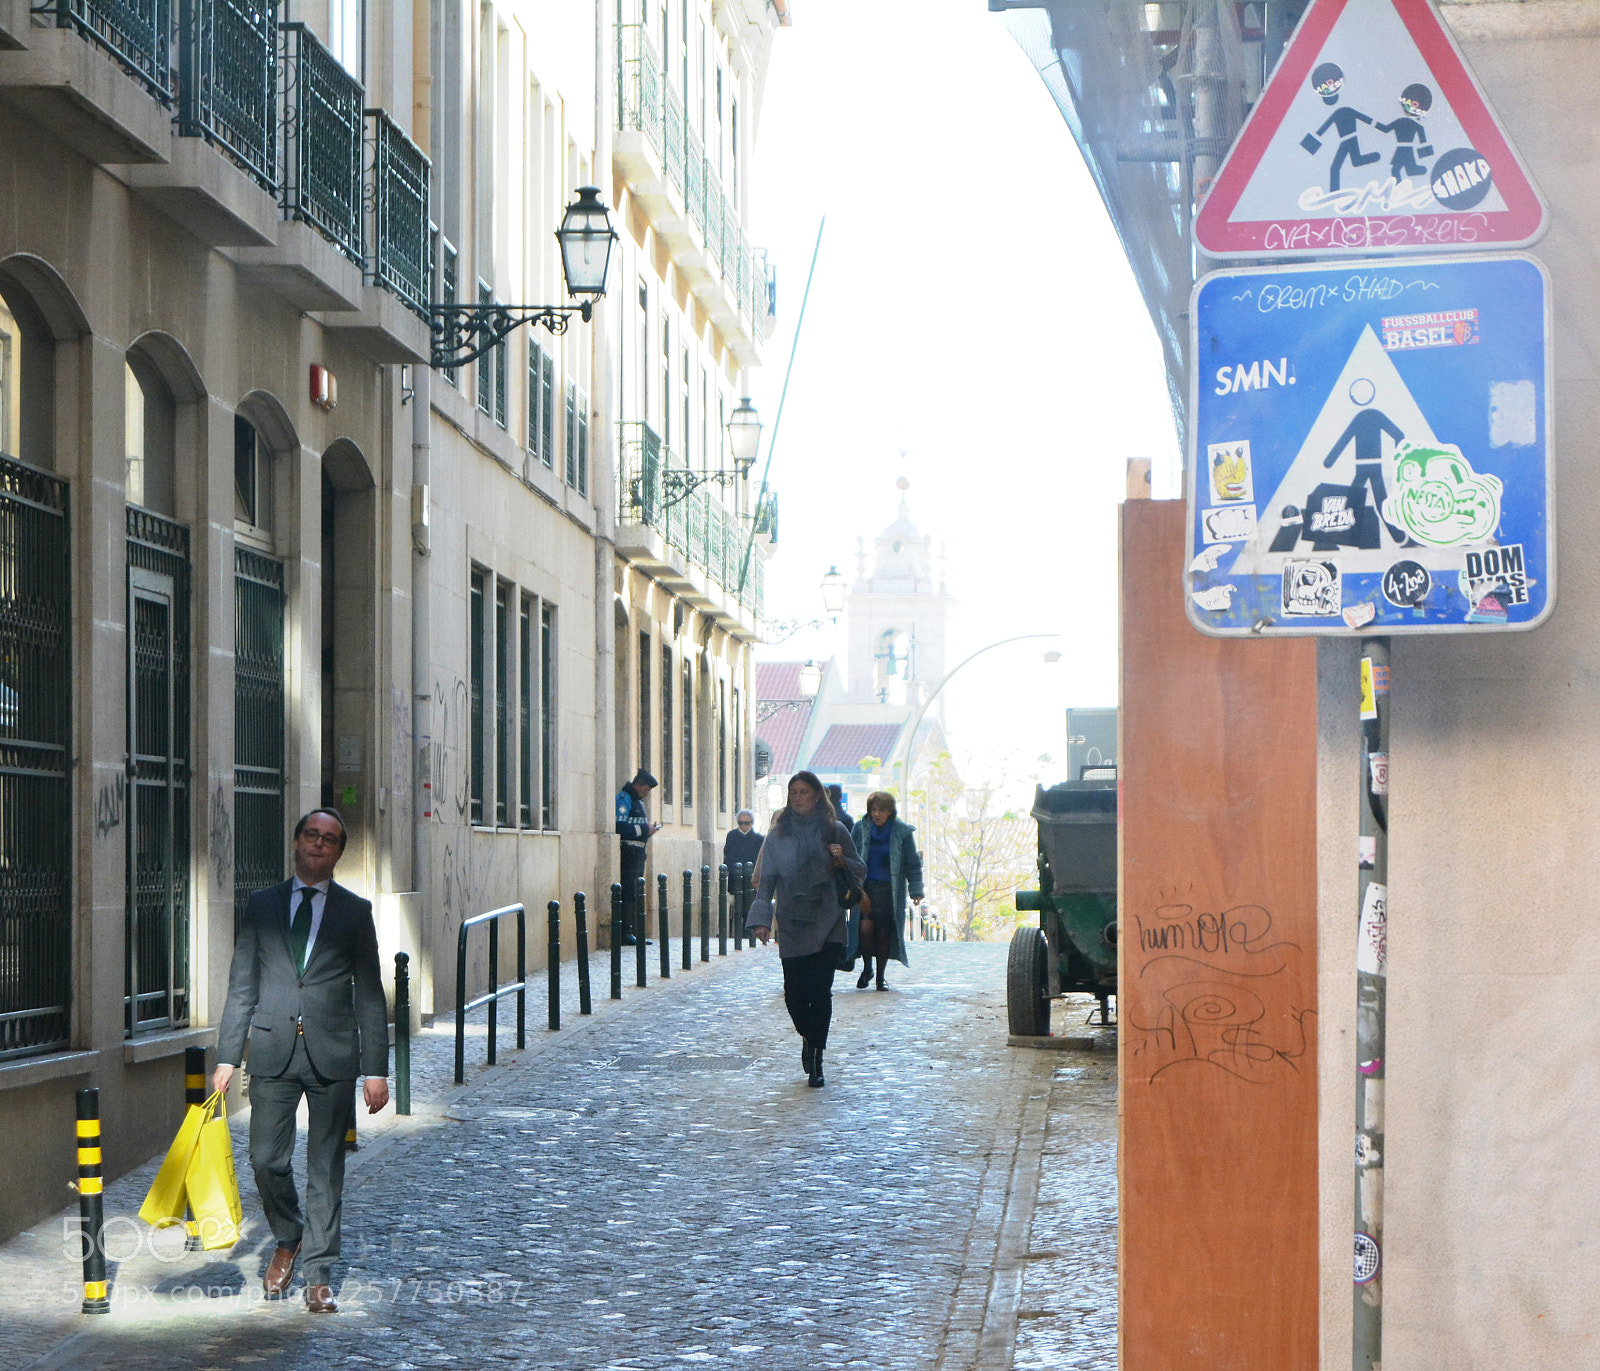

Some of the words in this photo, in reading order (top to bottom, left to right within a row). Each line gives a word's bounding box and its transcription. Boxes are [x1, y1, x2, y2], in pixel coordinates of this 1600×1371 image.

[1384, 309, 1474, 328] FUESSBALLCLUB
[1386, 327, 1452, 350] BASEL
[1214, 357, 1297, 396] SMN.
[1406, 488, 1446, 511] NESTA
[1465, 546, 1523, 578] DOM
